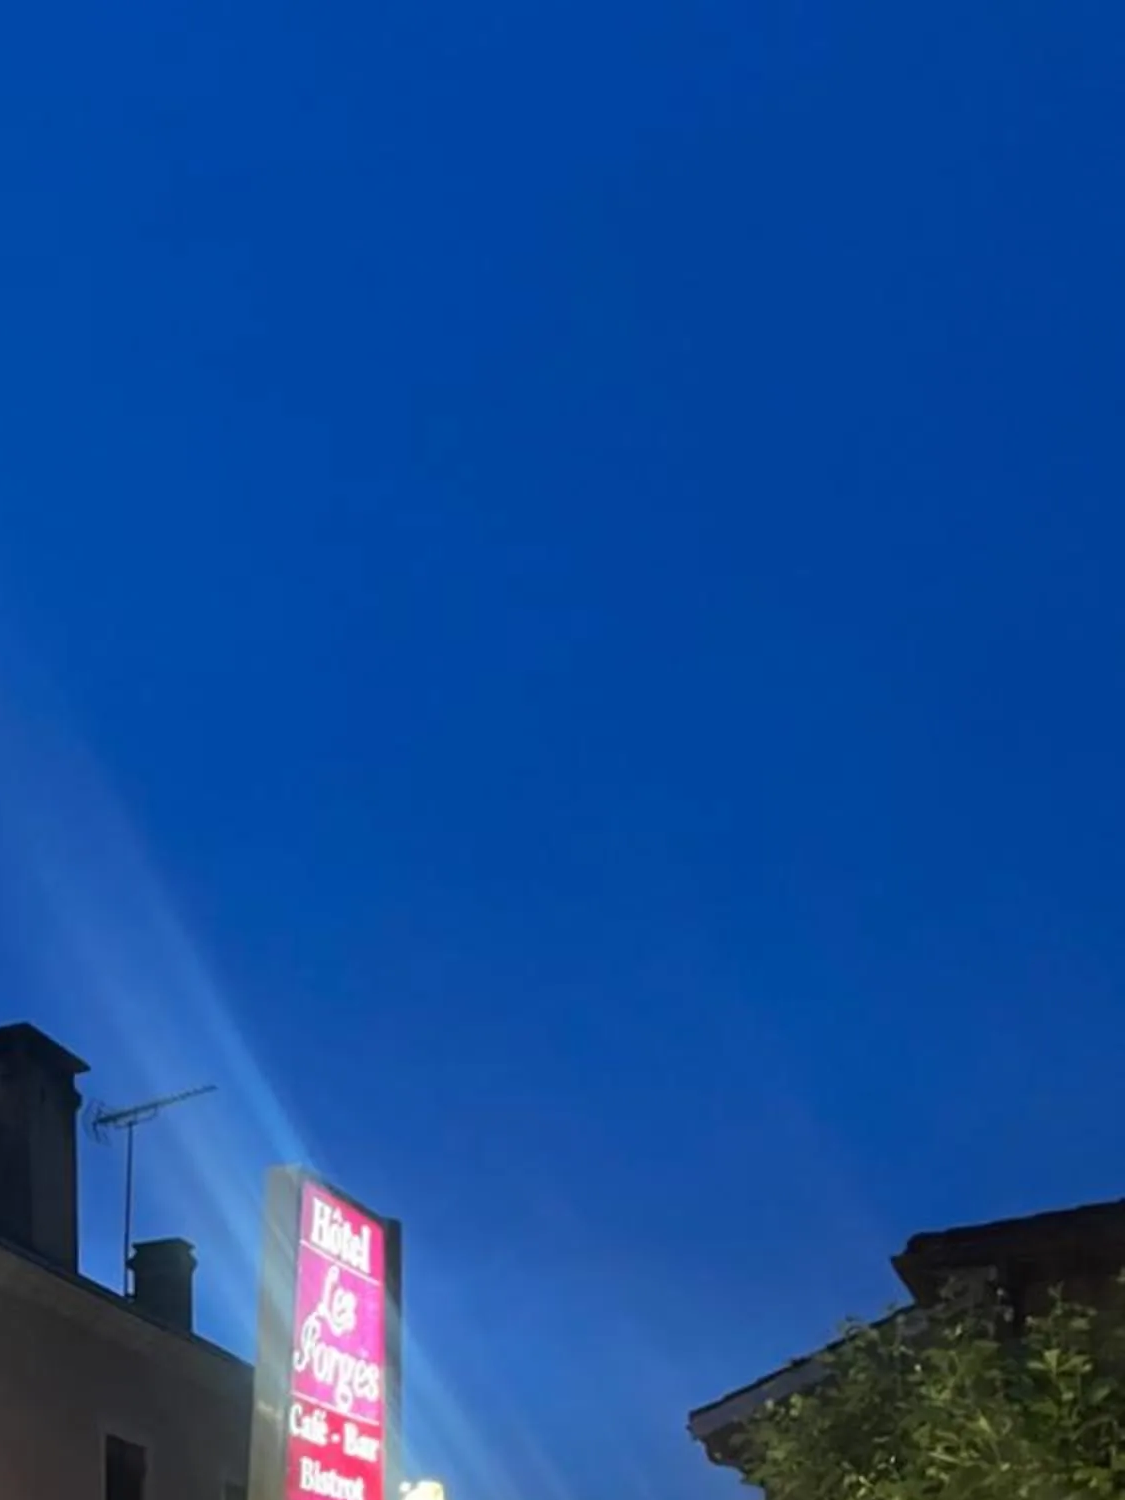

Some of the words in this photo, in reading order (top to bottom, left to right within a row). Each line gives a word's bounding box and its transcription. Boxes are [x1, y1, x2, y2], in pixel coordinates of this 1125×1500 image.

[311, 1197, 371, 1274] Hôtel
[289, 1404, 329, 1447] Café
[343, 1422, 380, 1463] Bar
